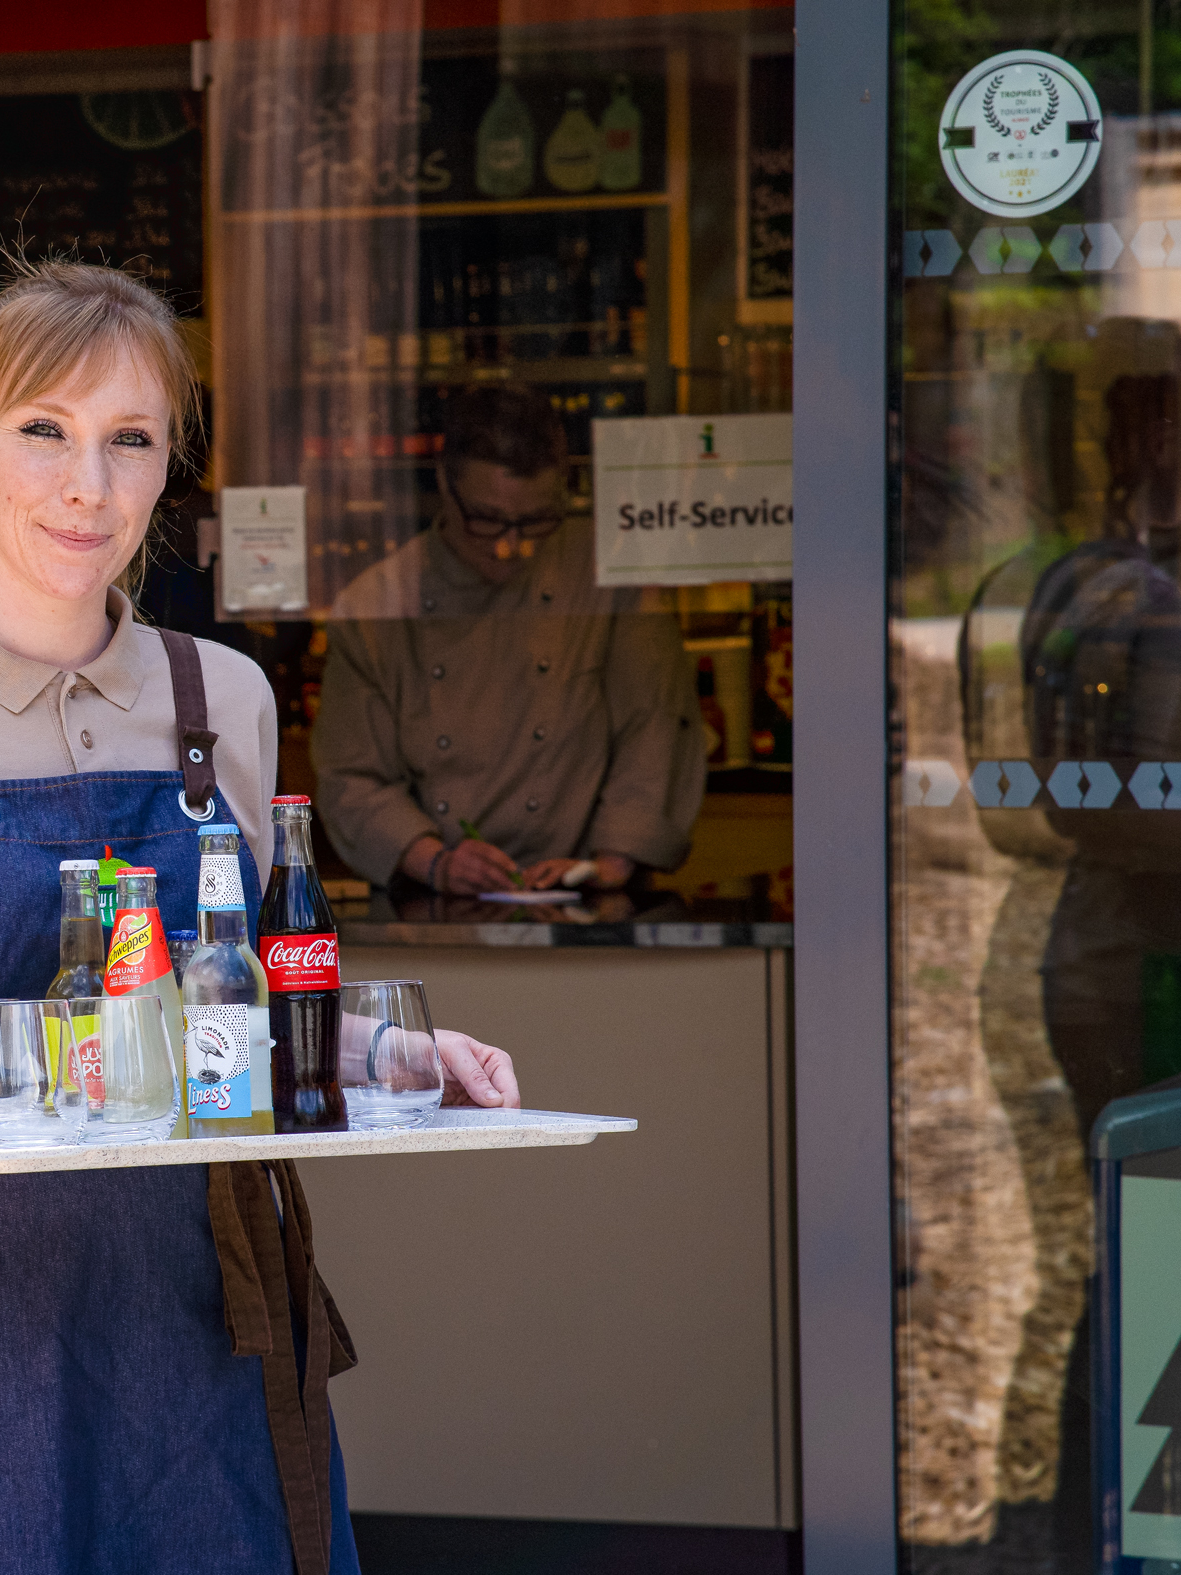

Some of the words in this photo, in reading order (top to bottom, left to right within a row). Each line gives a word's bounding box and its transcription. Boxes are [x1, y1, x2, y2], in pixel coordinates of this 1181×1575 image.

[1000, 89, 1042, 98] TROPHÉES
[1000, 107, 1042, 116] TOURISME
[618, 498, 793, 531] Self-Servic
[267, 939, 336, 970] Coca-Cola
[108, 966, 144, 977] AGRUMES
[201, 1025, 230, 1051] LIMONADE
[204, 1031, 223, 1049] TRADITION
